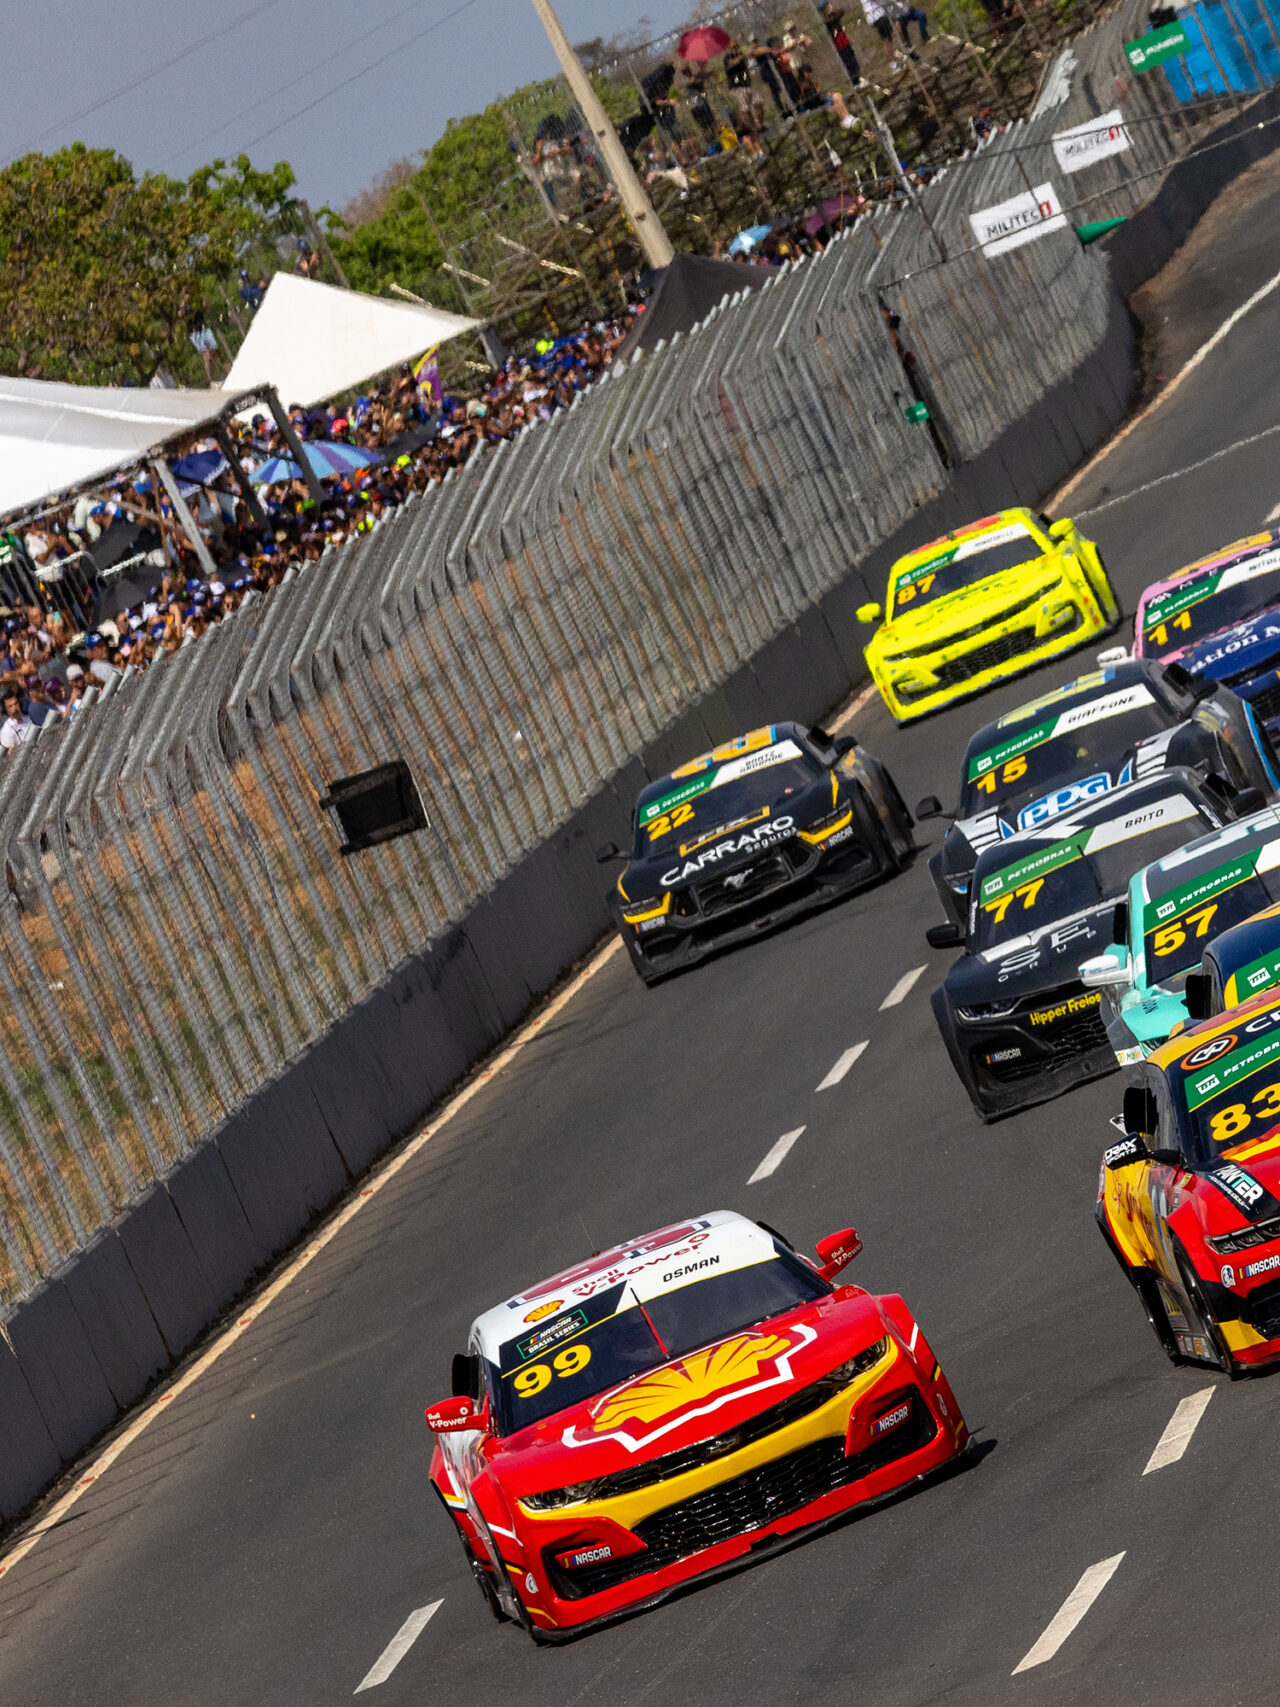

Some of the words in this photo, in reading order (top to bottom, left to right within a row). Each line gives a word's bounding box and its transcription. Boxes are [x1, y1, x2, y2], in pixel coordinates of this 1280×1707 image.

[986, 209, 1039, 239] MILITEC
[897, 574, 936, 605] 87
[1149, 610, 1193, 646] 11
[1068, 695, 1136, 724] GIAFFONE
[977, 755, 1028, 794] 15
[1023, 775, 1110, 829] PPG
[647, 803, 695, 841] 22
[1125, 809, 1164, 829] BRITO
[660, 815, 795, 886] CARRARO
[1007, 846, 1073, 881] PETROBRAS
[985, 878, 1045, 924] 77
[1179, 867, 1242, 904] PETROBRAS
[1154, 904, 1218, 957] 57
[1030, 1004, 1067, 1026] Hipper
[993, 1048, 1022, 1062] NASCAR
[1104, 1137, 1138, 1161] DRAX
[1212, 1163, 1264, 1206] PANTER
[574, 1243, 703, 1297] V-Power
[662, 1255, 721, 1283] OSMAN
[1249, 1255, 1280, 1278] NASCAR
[528, 1335, 555, 1354] BRASIL
[555, 1321, 581, 1340] SERIES
[540, 1317, 573, 1337] NASCAR
[513, 1344, 592, 1398] 99
[429, 1417, 467, 1429] V-Power
[879, 1404, 909, 1433] NASCAR
[575, 1545, 612, 1567] NASCAR
